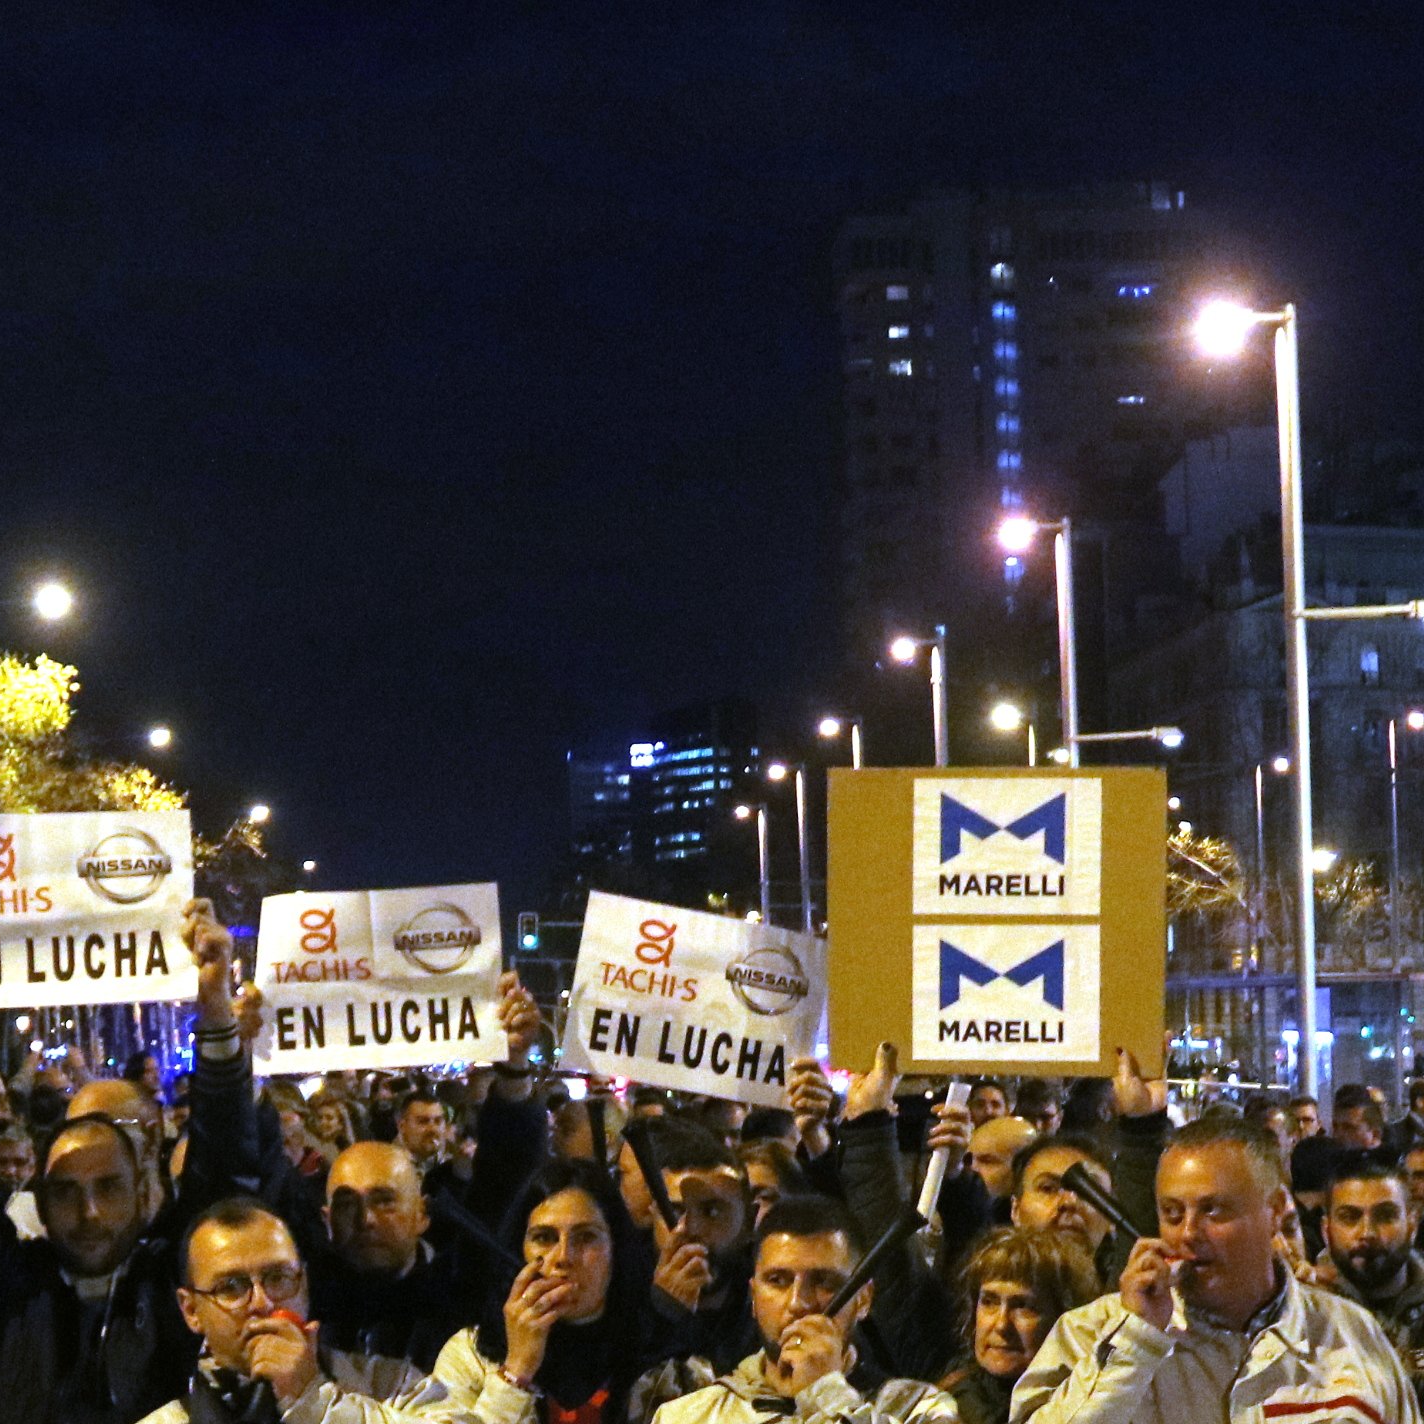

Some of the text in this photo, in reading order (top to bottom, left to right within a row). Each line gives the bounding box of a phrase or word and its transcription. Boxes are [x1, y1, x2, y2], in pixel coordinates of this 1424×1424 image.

[84, 858, 164, 873] NISSAN
[938, 874, 1066, 897] MARELLI
[401, 930, 473, 946] NISSAN
[26, 930, 170, 984] LUCHA
[732, 966, 802, 992] NISSAN
[277, 996, 480, 1051] EN LUCHA
[938, 1020, 1065, 1043] MARELLI
[589, 1008, 786, 1086] EN LUCHA
